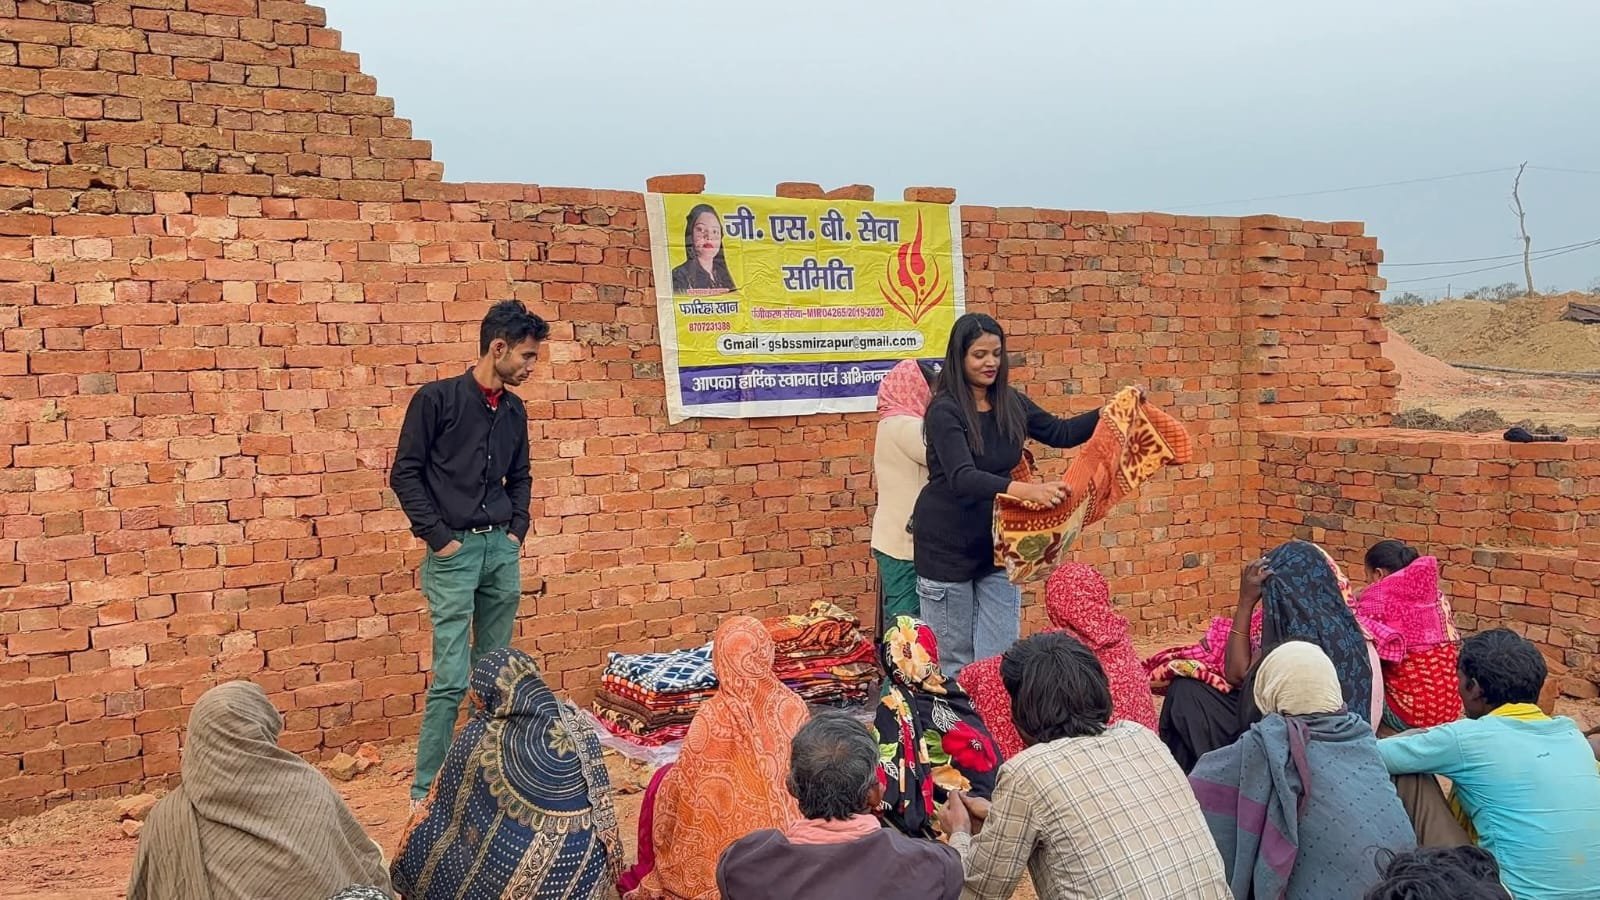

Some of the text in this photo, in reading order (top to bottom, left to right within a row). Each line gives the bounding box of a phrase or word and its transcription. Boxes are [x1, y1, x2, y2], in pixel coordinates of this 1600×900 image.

[724, 206, 899, 242] जी. एस. बी. सेवा
[782, 258, 854, 290] समिति
[716, 301, 738, 314] खान
[723, 337, 758, 350] Gmail
[768, 335, 916, 352] gsbssmirzapur@gmail.com
[692, 375, 736, 391] आपका
[738, 369, 776, 389] हार्दिक
[777, 373, 818, 388] स्वागत
[820, 367, 838, 387] एवं
